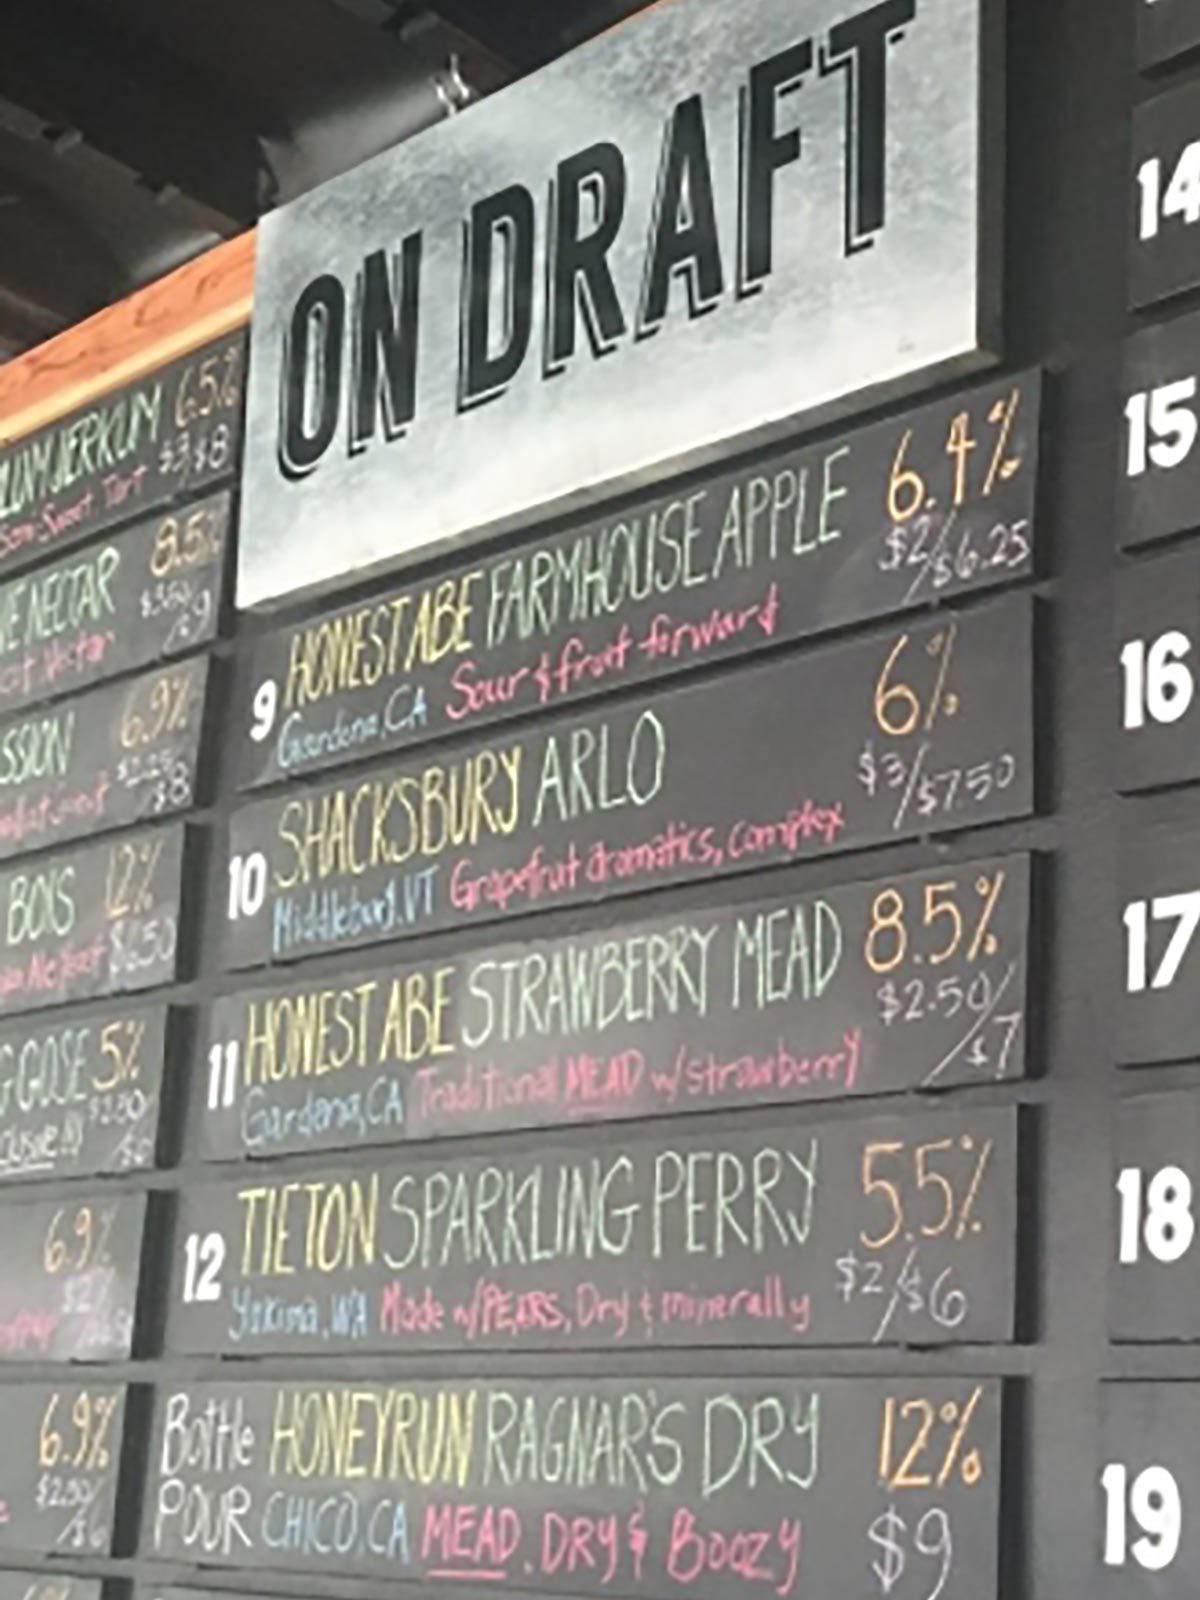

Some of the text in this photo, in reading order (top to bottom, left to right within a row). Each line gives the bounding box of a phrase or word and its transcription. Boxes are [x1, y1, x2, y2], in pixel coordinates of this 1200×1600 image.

[278, 0, 916, 481] ON DRAFT
[887, 388, 1021, 521] 6.4%
[1122, 375, 1199, 476] 15
[283, 446, 851, 708] HONEST ABE FARMHOUSE APPLE
[445, 660, 530, 720] Sour
[638, 583, 780, 660] forward
[874, 622, 958, 736] 6%
[1120, 630, 1194, 730] 16
[249, 679, 278, 742] 9
[275, 710, 666, 888] SHACKSBURY ARLO
[5, 866, 76, 945] BOIS
[228, 852, 266, 919] 10
[864, 871, 1005, 974] 8.5%
[245, 899, 842, 1086] HONEST ABE STRAWBERRY MEAD
[208, 1040, 238, 1110] 11
[563, 1044, 647, 1104] MEAD
[238, 1137, 818, 1277] TIETON SPARKLING PERRY
[1115, 1165, 1196, 1264] 18
[184, 1232, 226, 1303] 12
[378, 1281, 446, 1335] Made
[39, 1389, 117, 1470] 6.9%
[160, 1392, 256, 1476] Bottle
[702, 1391, 820, 1498] DRY
[878, 1386, 982, 1490] 12%
[154, 1477, 253, 1556] POUR
[868, 1504, 954, 1600] $9
[1101, 1462, 1184, 1571] 19
